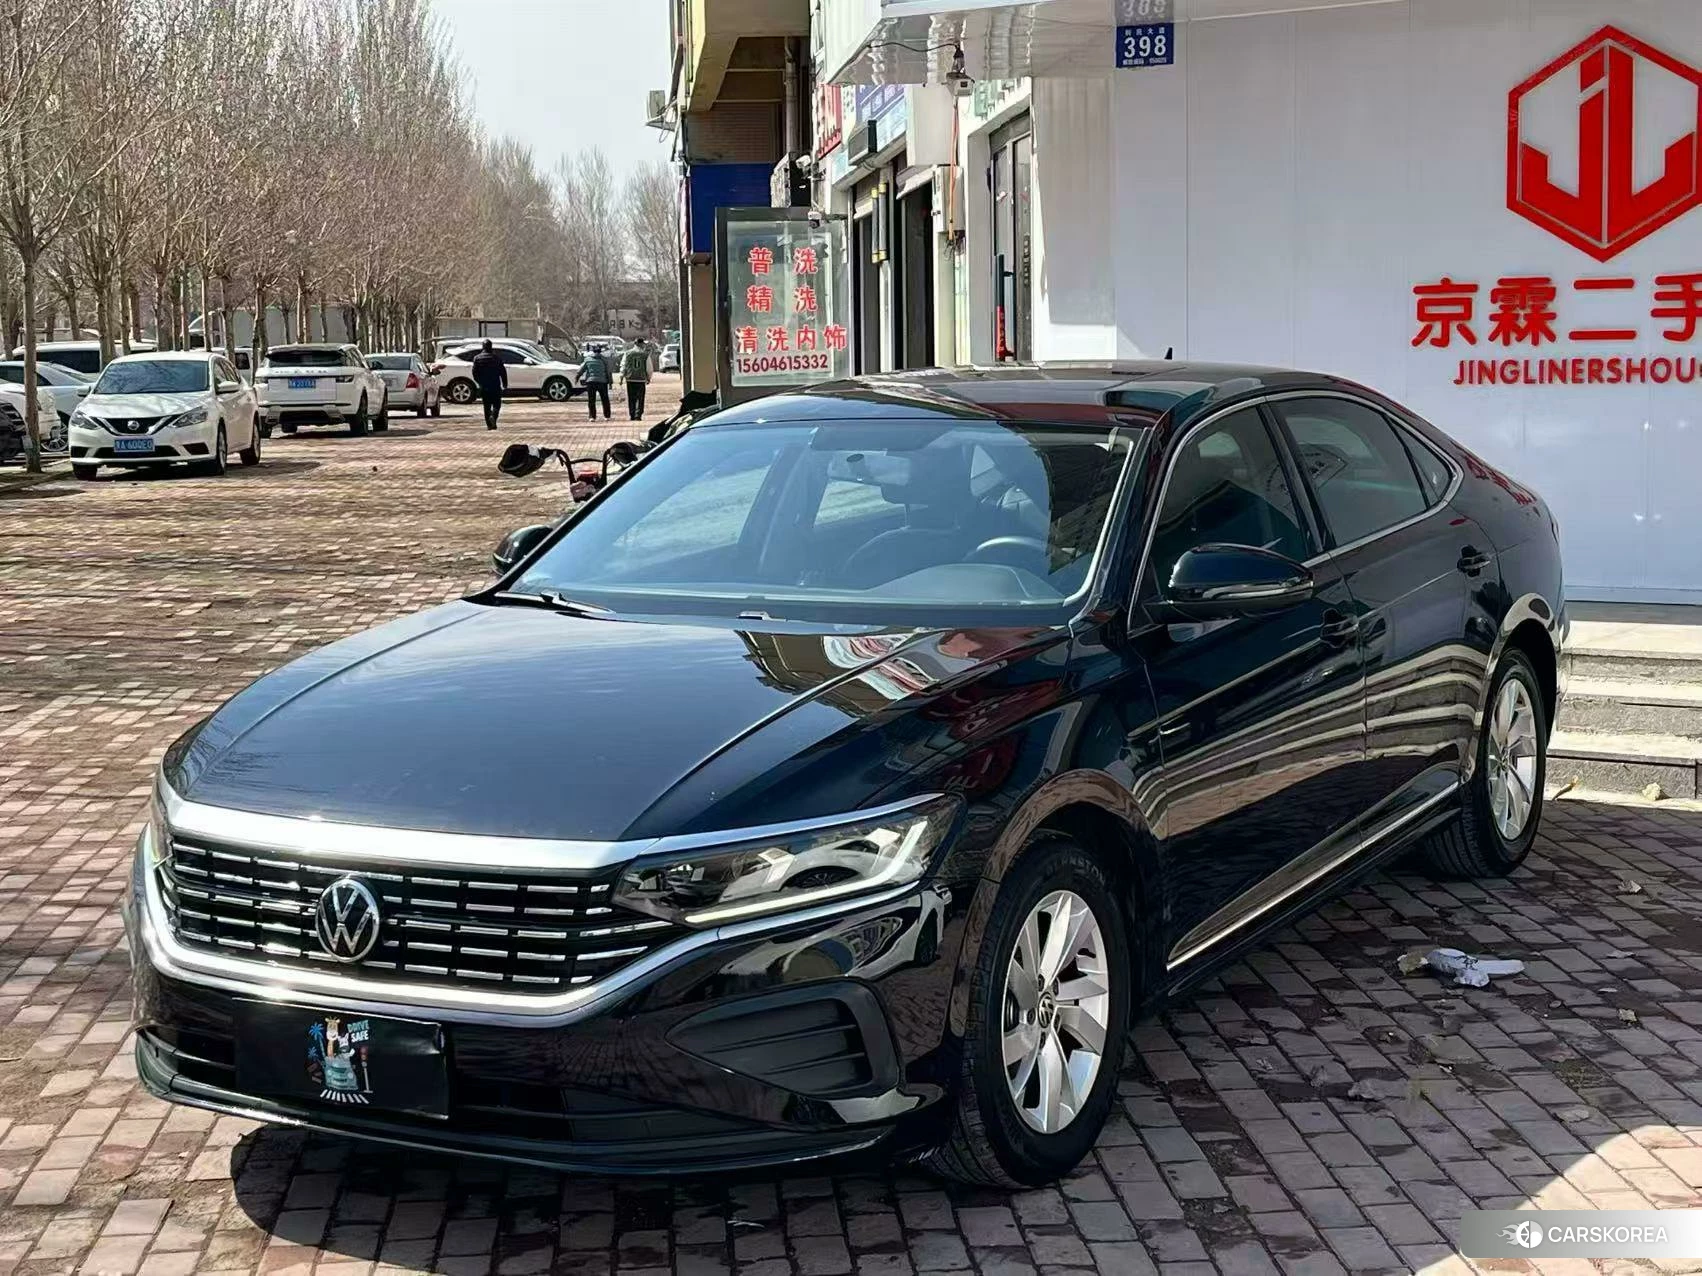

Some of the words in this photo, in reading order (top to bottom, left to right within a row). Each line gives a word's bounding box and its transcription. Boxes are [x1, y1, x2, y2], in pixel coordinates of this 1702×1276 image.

[1124, 35, 1166, 58] 398
[748, 246, 818, 275] 普洗
[747, 285, 818, 313] 精洗
[1411, 274, 1702, 349] 京霖二手
[735, 324, 847, 354] 清洗内饰
[737, 354, 828, 373] 15604615332
[1453, 357, 1702, 386] JINGLINERSHOU
[351, 1030, 369, 1042] SAFE
